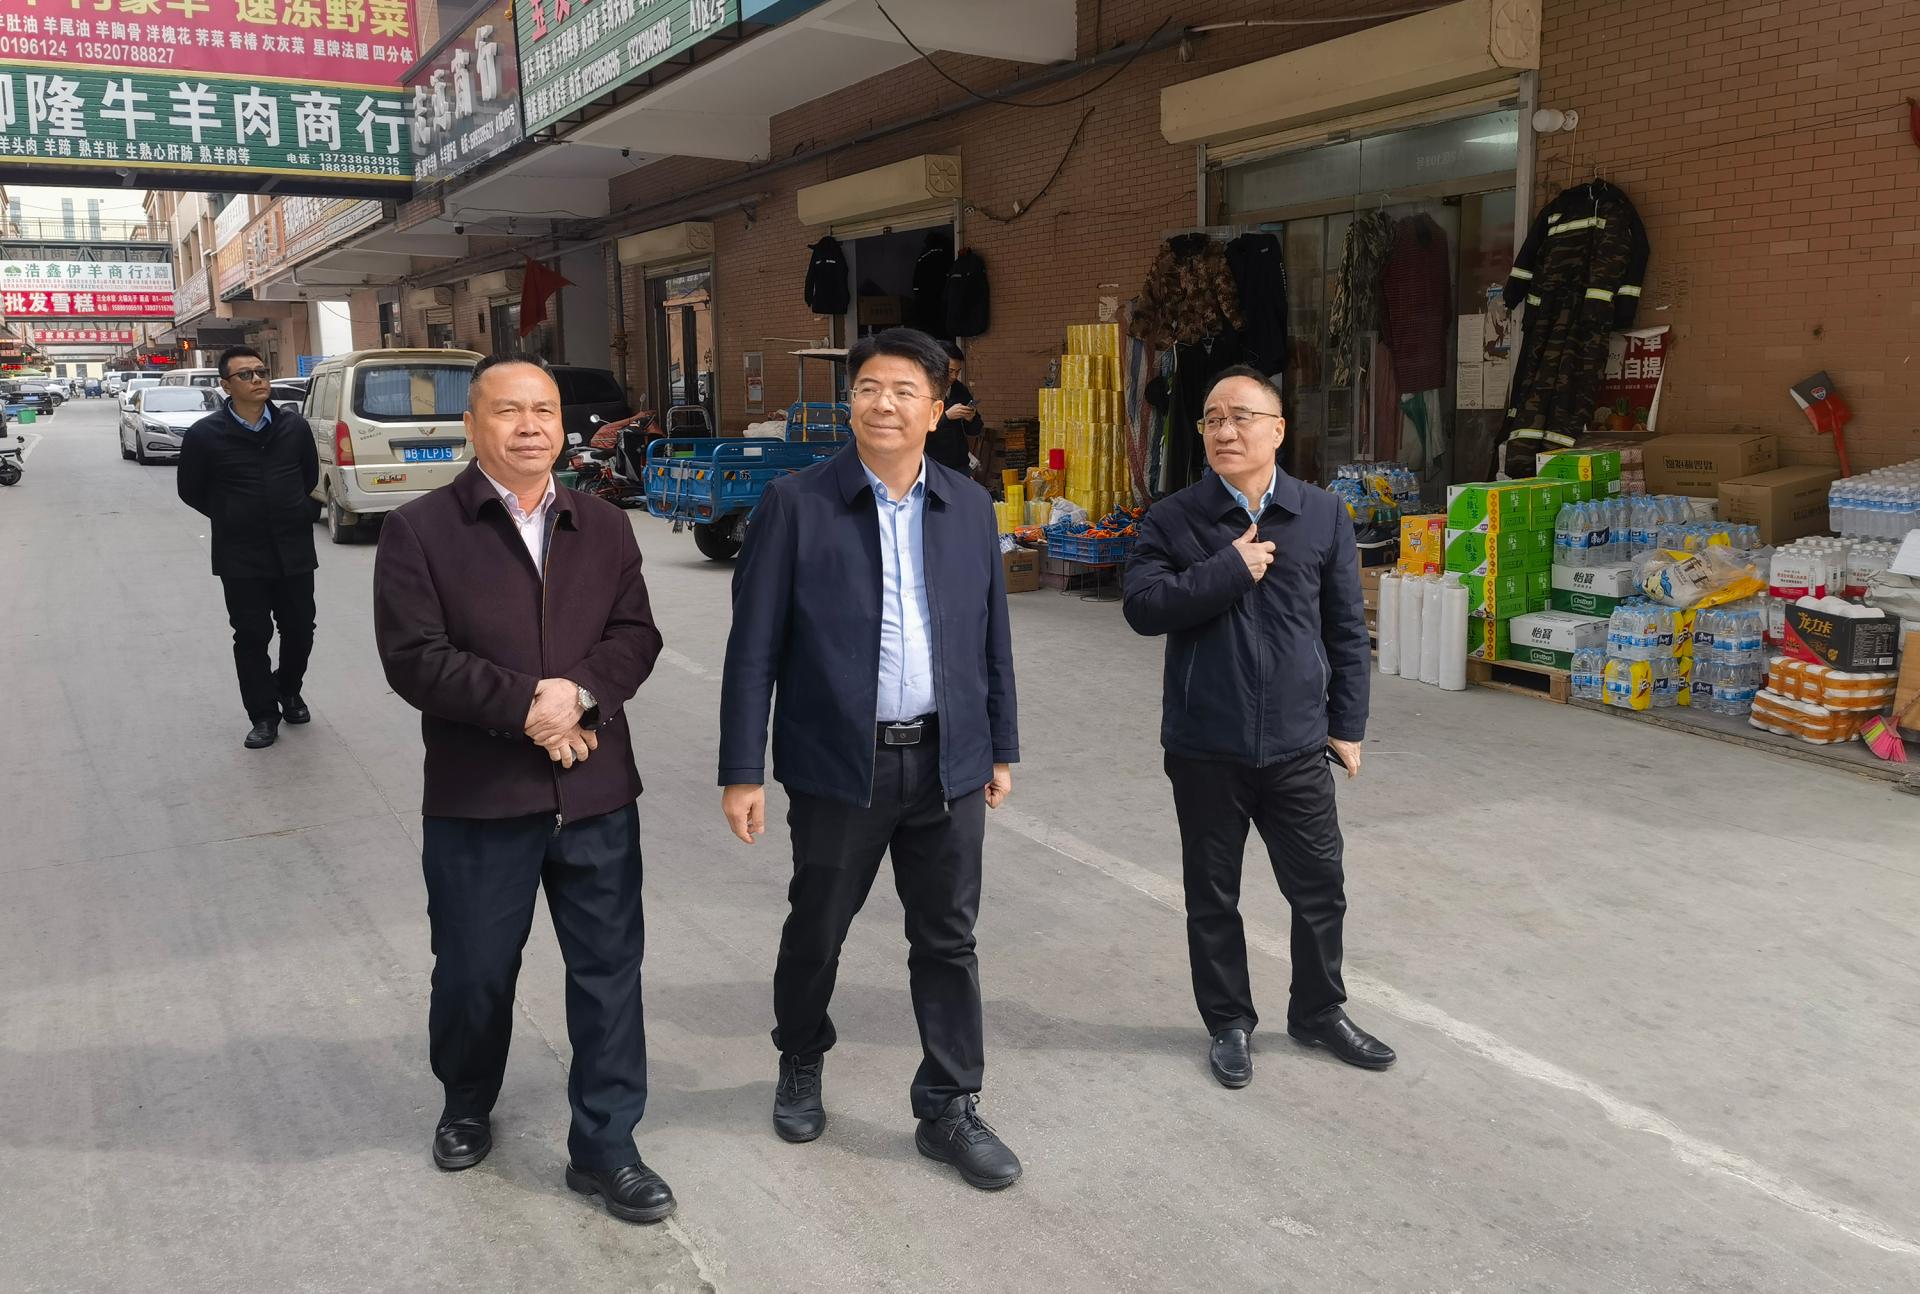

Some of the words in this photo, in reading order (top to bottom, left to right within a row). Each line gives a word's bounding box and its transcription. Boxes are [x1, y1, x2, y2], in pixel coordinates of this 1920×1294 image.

[236, 0, 409, 37] 速冻野菜
[44, 16, 90, 37] 羊尾油
[96, 20, 141, 42] 羊胸骨
[147, 24, 191, 45] 洋槐花
[196, 28, 224, 48] 荠菜
[229, 31, 257, 51] 香椿
[262, 34, 305, 55] 灰灰菜
[372, 45, 414, 65] 四分体
[75, 42, 175, 64] 13520788827
[0, 136, 37, 155] 羊头肉
[44, 139, 71, 157] 羊蹄
[78, 139, 119, 159] 熟羊肚
[126, 142, 193, 162] 生熟心肝肺
[200, 146, 250, 165] 熟羊肉等
[319, 152, 400, 166] 13733863935
[320, 163, 400, 176] 18838283716
[25, 263, 143, 279] 浩鑫伊羊商行
[4, 292, 94, 313] 批发雪糕
